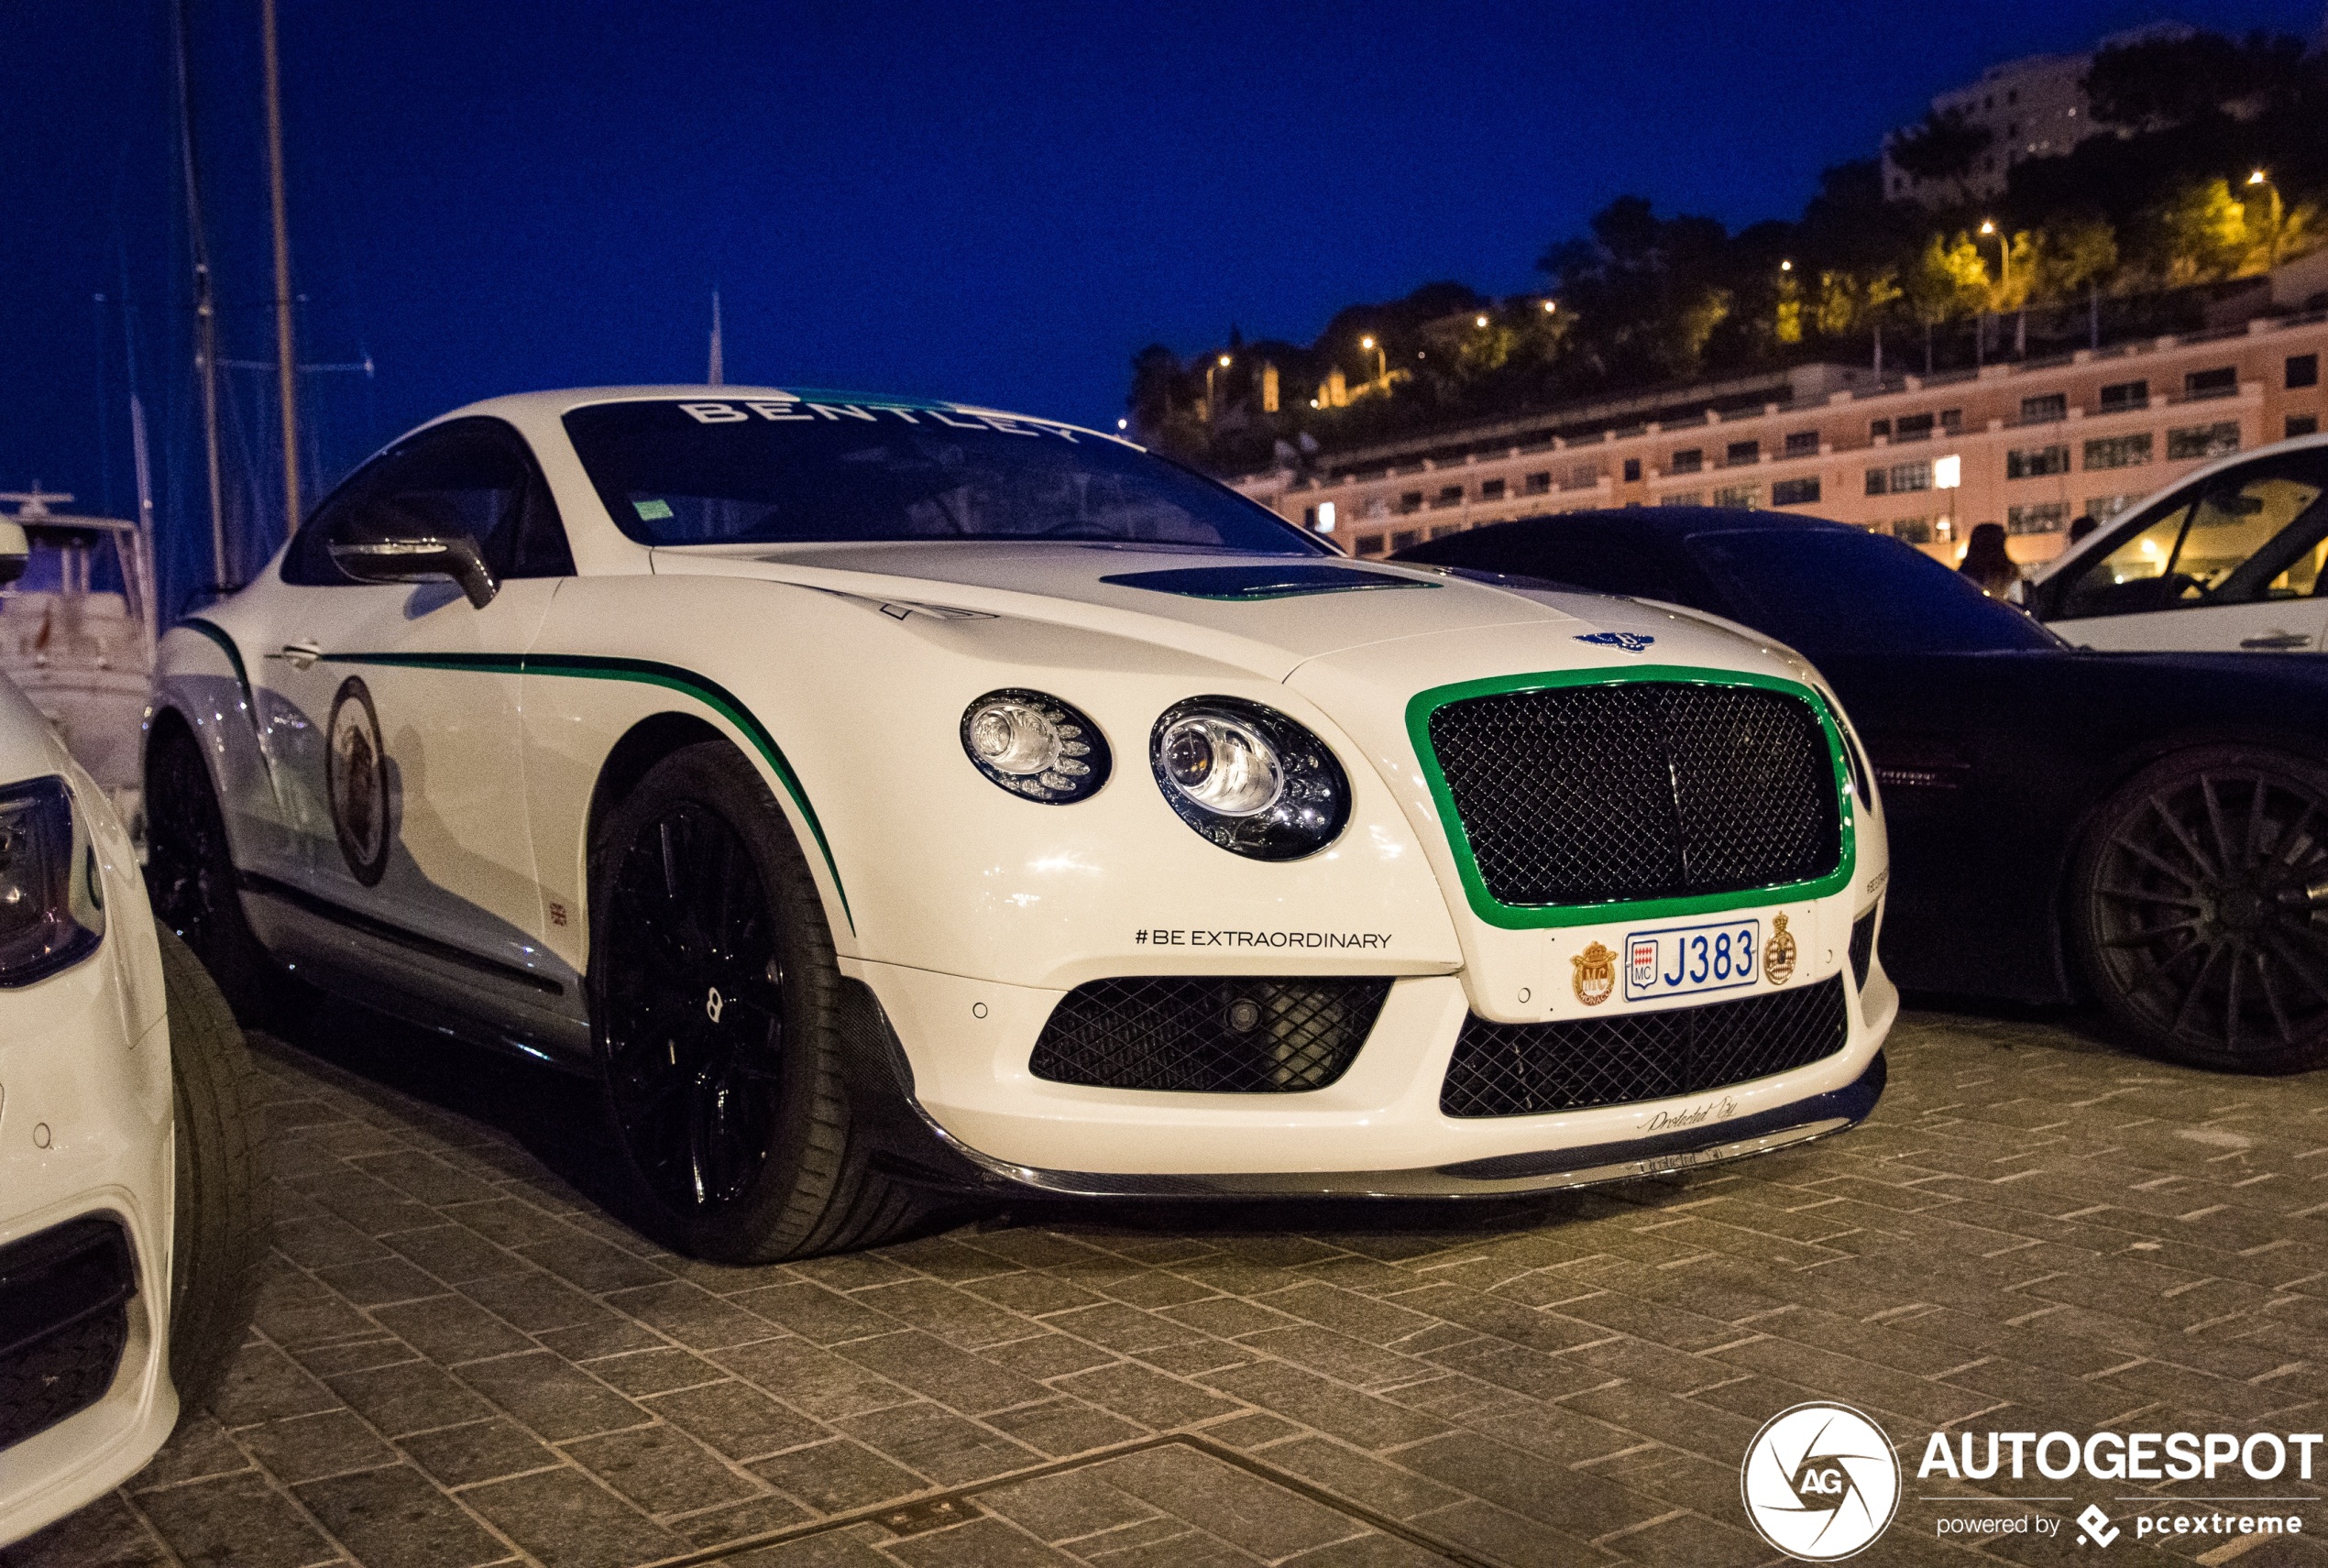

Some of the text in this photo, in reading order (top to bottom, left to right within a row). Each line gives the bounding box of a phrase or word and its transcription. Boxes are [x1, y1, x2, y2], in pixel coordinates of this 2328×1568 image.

[678, 401, 1079, 443] BENTLEY
[1191, 930, 1392, 948] EXTRAORDINARY
[1664, 929, 1752, 986] J383
[1585, 968, 1607, 991] MC
[1634, 966, 1651, 981] MC
[1578, 989, 1611, 1004] MONACO
